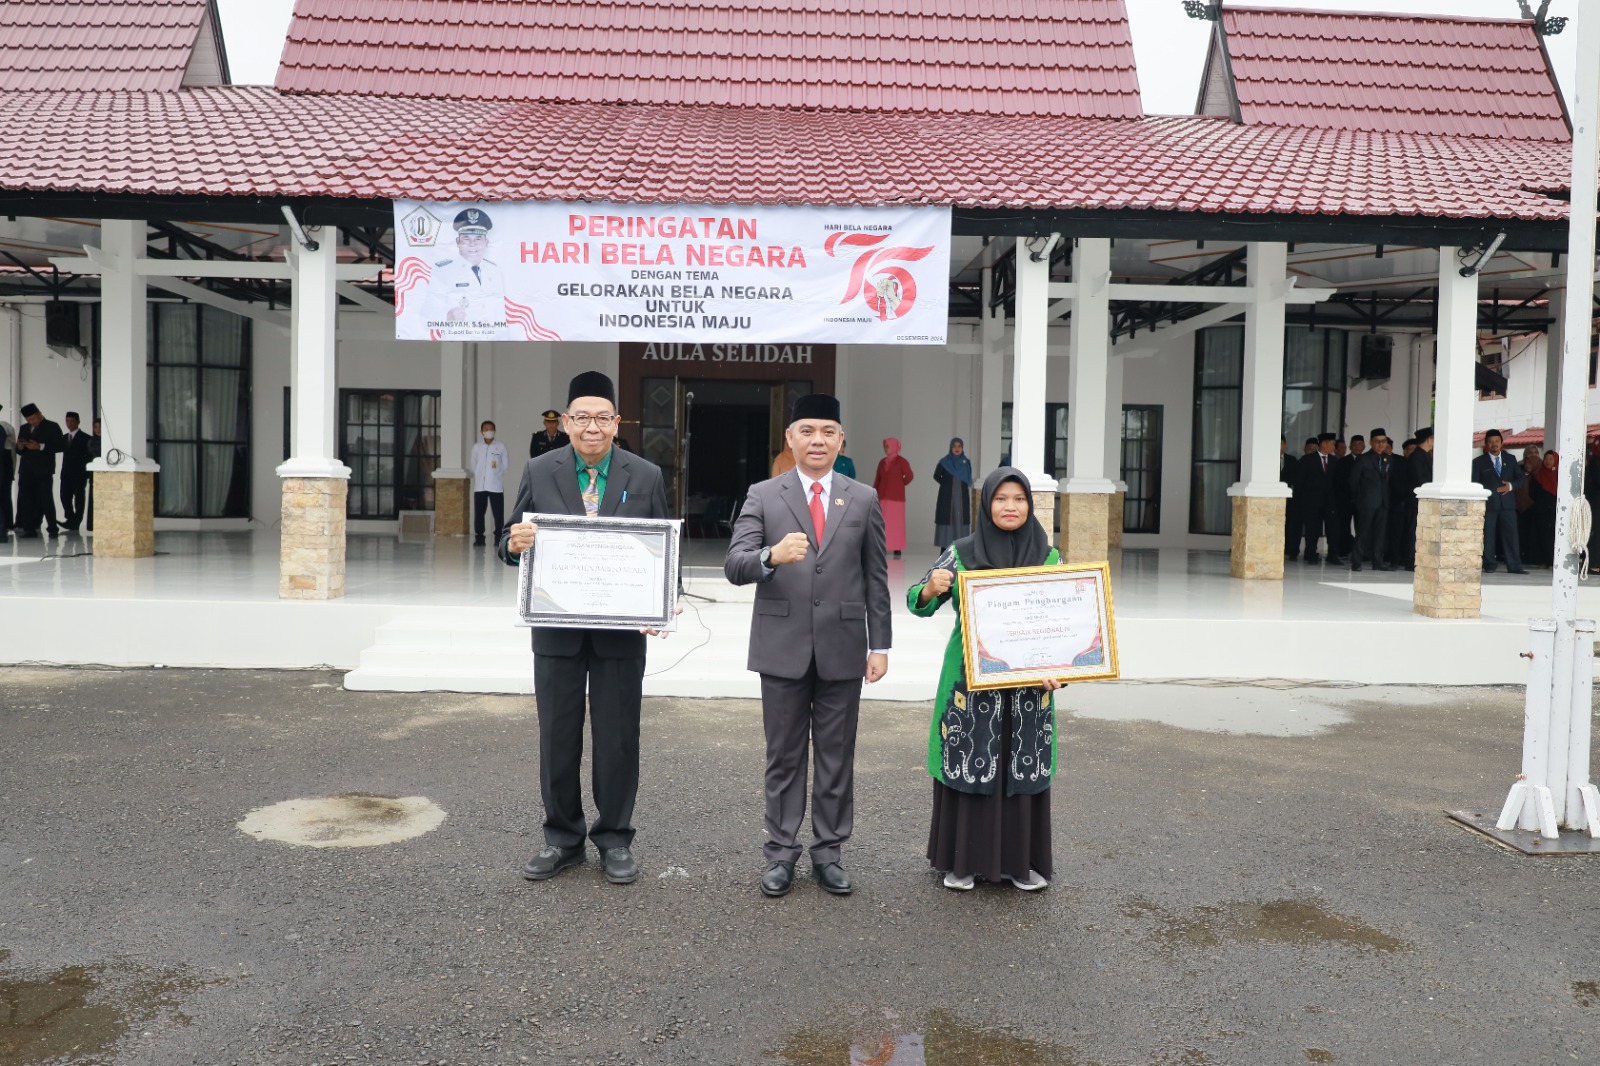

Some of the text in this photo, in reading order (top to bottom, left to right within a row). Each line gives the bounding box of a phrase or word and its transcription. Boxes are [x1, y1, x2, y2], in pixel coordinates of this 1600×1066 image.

[569, 214, 757, 240] PERINGATAN
[520, 242, 807, 268] HARI BELA NEGARA
[631, 269, 719, 281] DENGAN TEMA
[557, 282, 794, 300] GELORAKAN BELA NEGARA
[646, 300, 705, 314] UNTUK
[599, 313, 752, 329] INDONESIA MAJU
[642, 342, 813, 364] AULA SELIDAH
